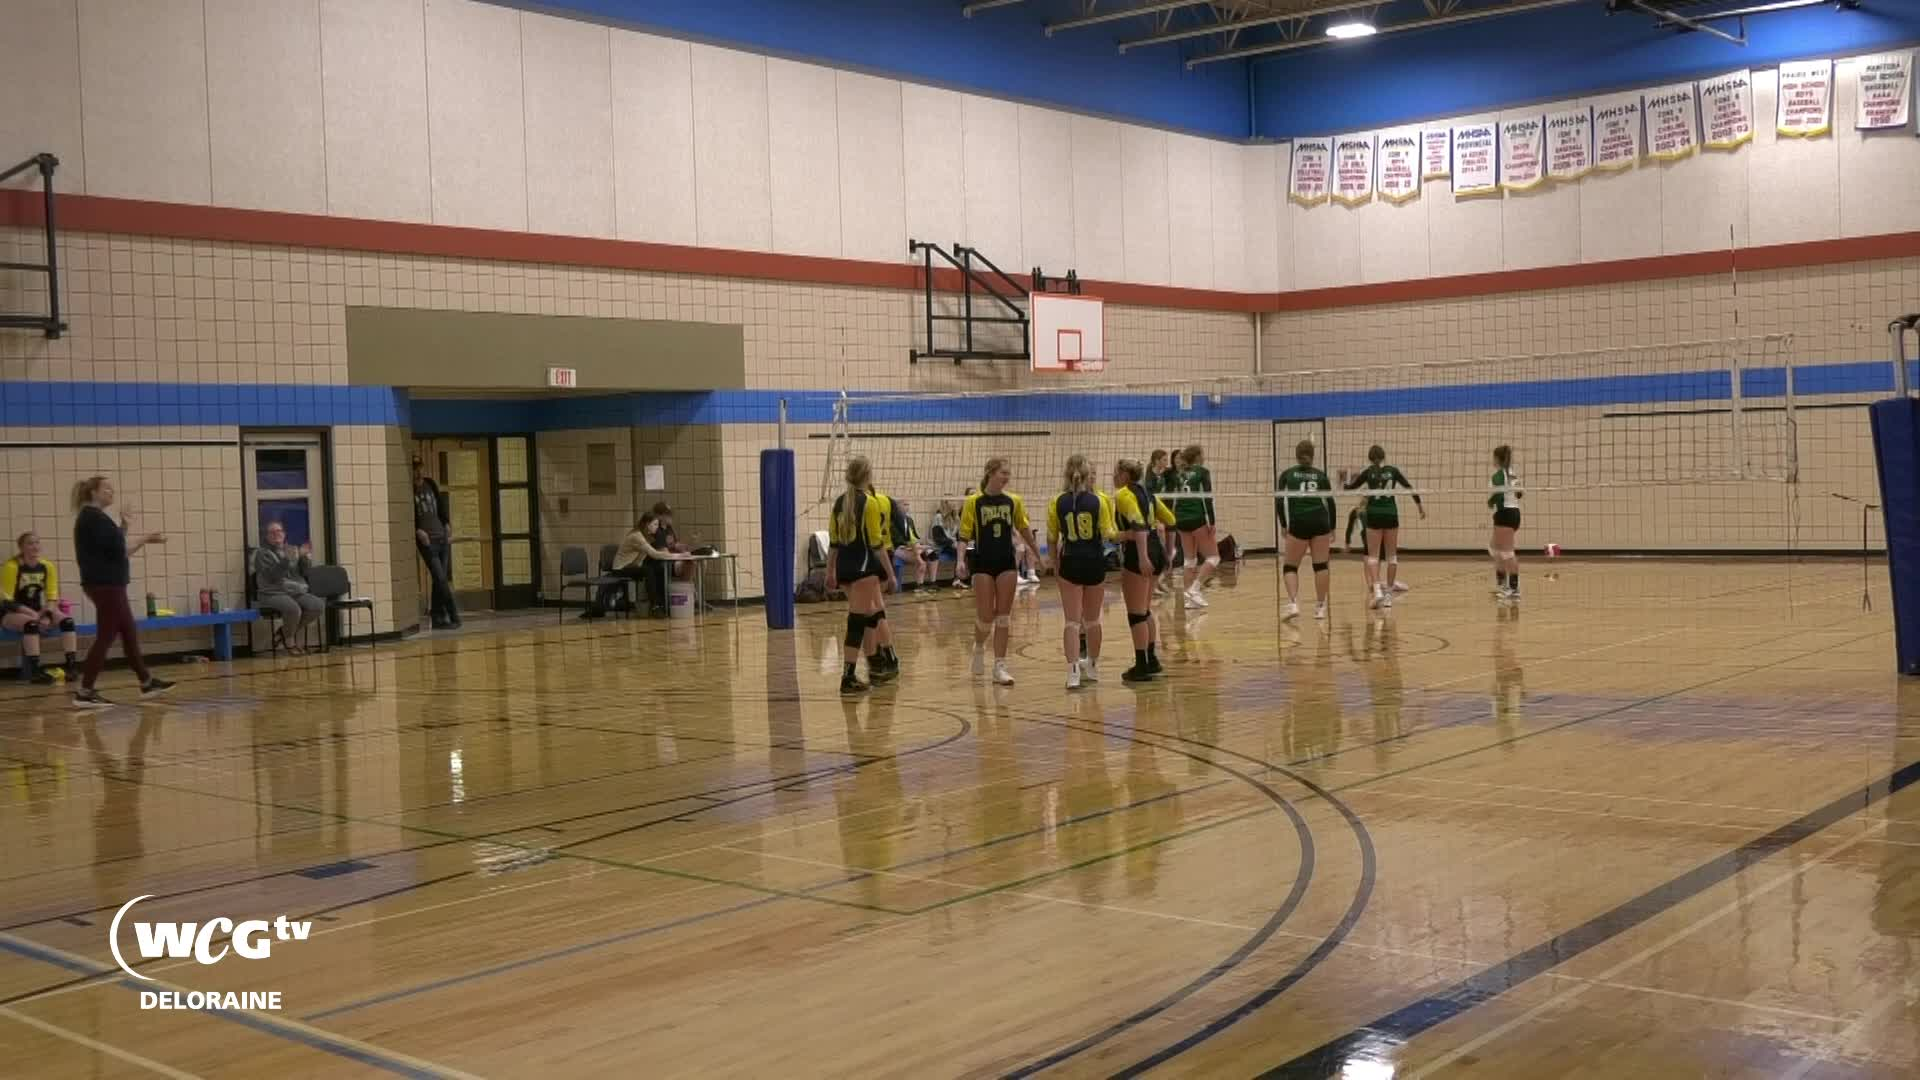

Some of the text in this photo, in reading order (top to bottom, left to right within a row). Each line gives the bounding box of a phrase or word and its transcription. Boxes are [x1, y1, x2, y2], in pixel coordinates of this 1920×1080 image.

[1866, 63, 1900, 71] MANITOBA
[1879, 71, 1905, 80] SCHOOL
[1865, 83, 1899, 91] BASEBALL
[1788, 99, 1820, 107] BASEBALL
[1863, 100, 1901, 108] CHAMPIONS
[1786, 107, 1822, 116] CHAMPIONS
[1710, 116, 1748, 130] CHAMPIONS
[1655, 129, 1690, 142] CHAMPIONS
[1457, 139, 1492, 149] PROVINCIAL
[555, 369, 570, 385] EXIT
